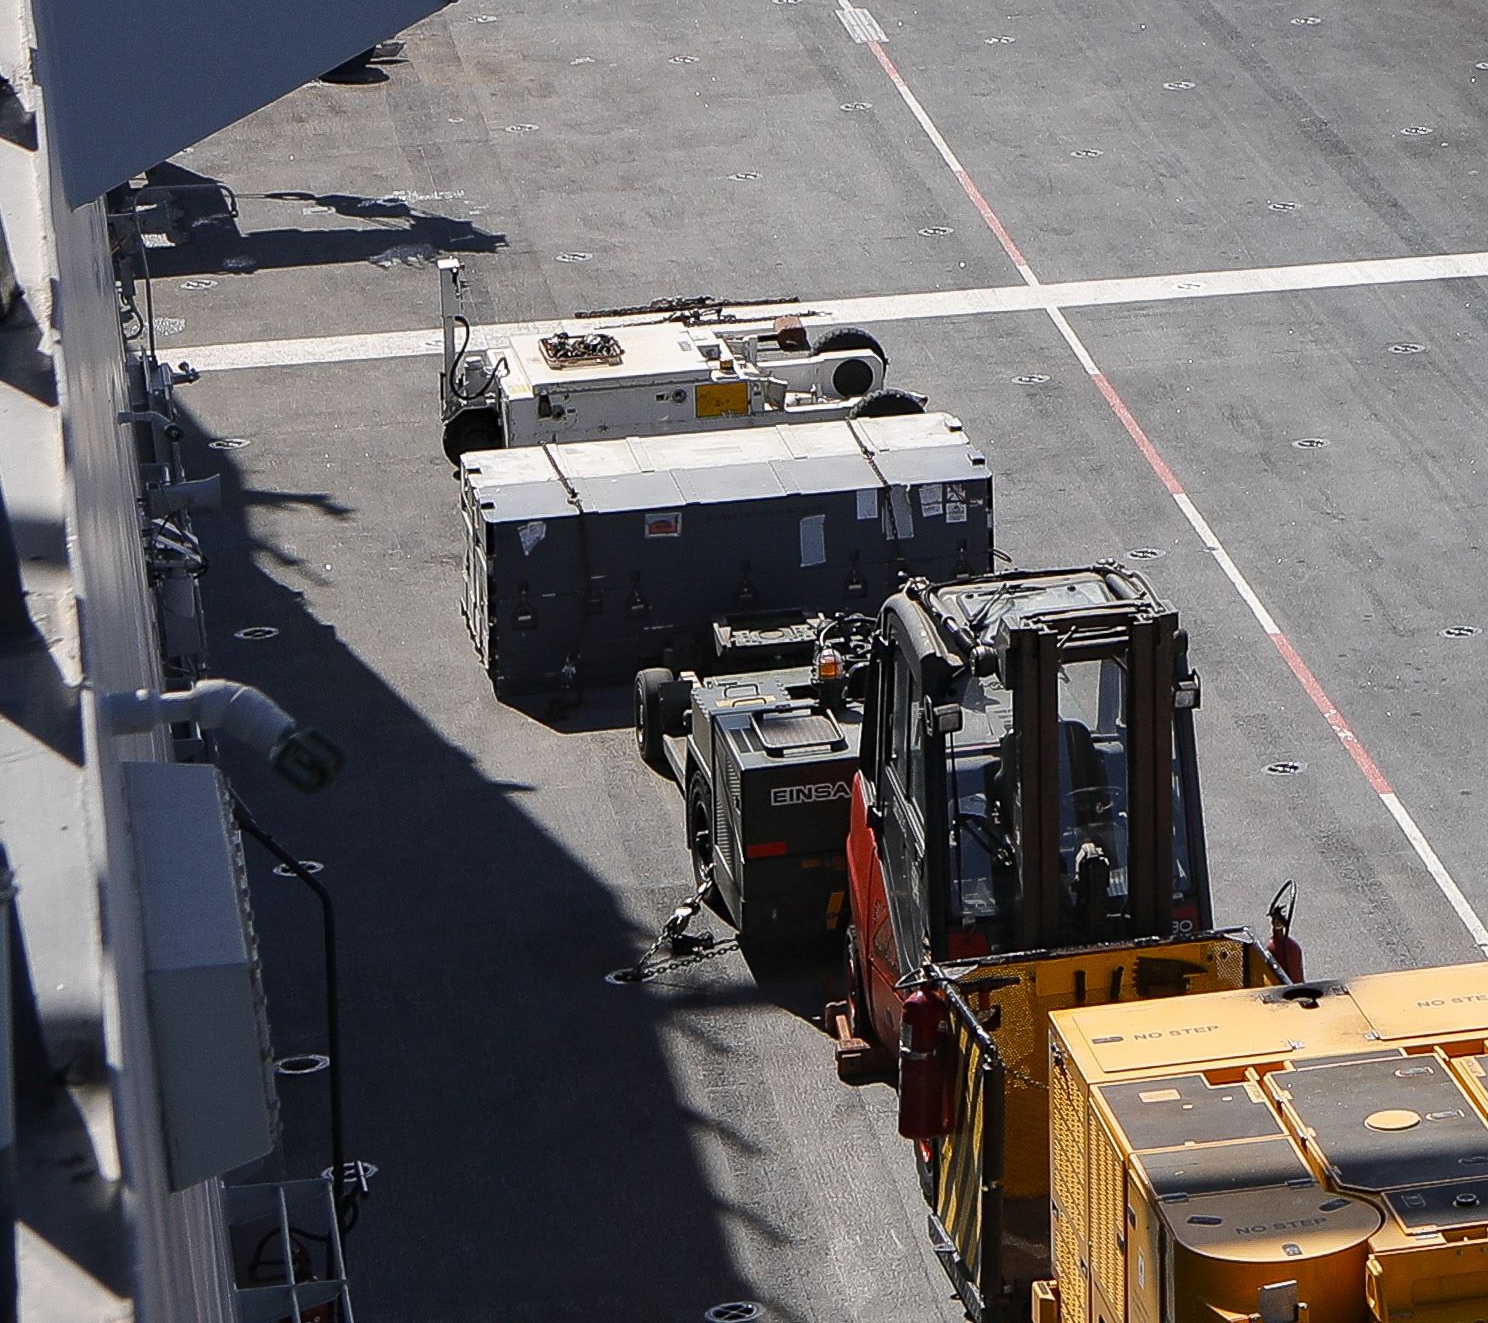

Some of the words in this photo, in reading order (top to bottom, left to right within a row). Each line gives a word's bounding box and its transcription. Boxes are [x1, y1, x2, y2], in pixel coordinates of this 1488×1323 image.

[770, 781, 852, 806] EINSA
[1416, 999, 1445, 1008] NO
[1133, 1032, 1163, 1041] NO
[1169, 1025, 1220, 1037] STEP
[1235, 1225, 1267, 1235] NO
[1272, 1217, 1327, 1231] STEP
